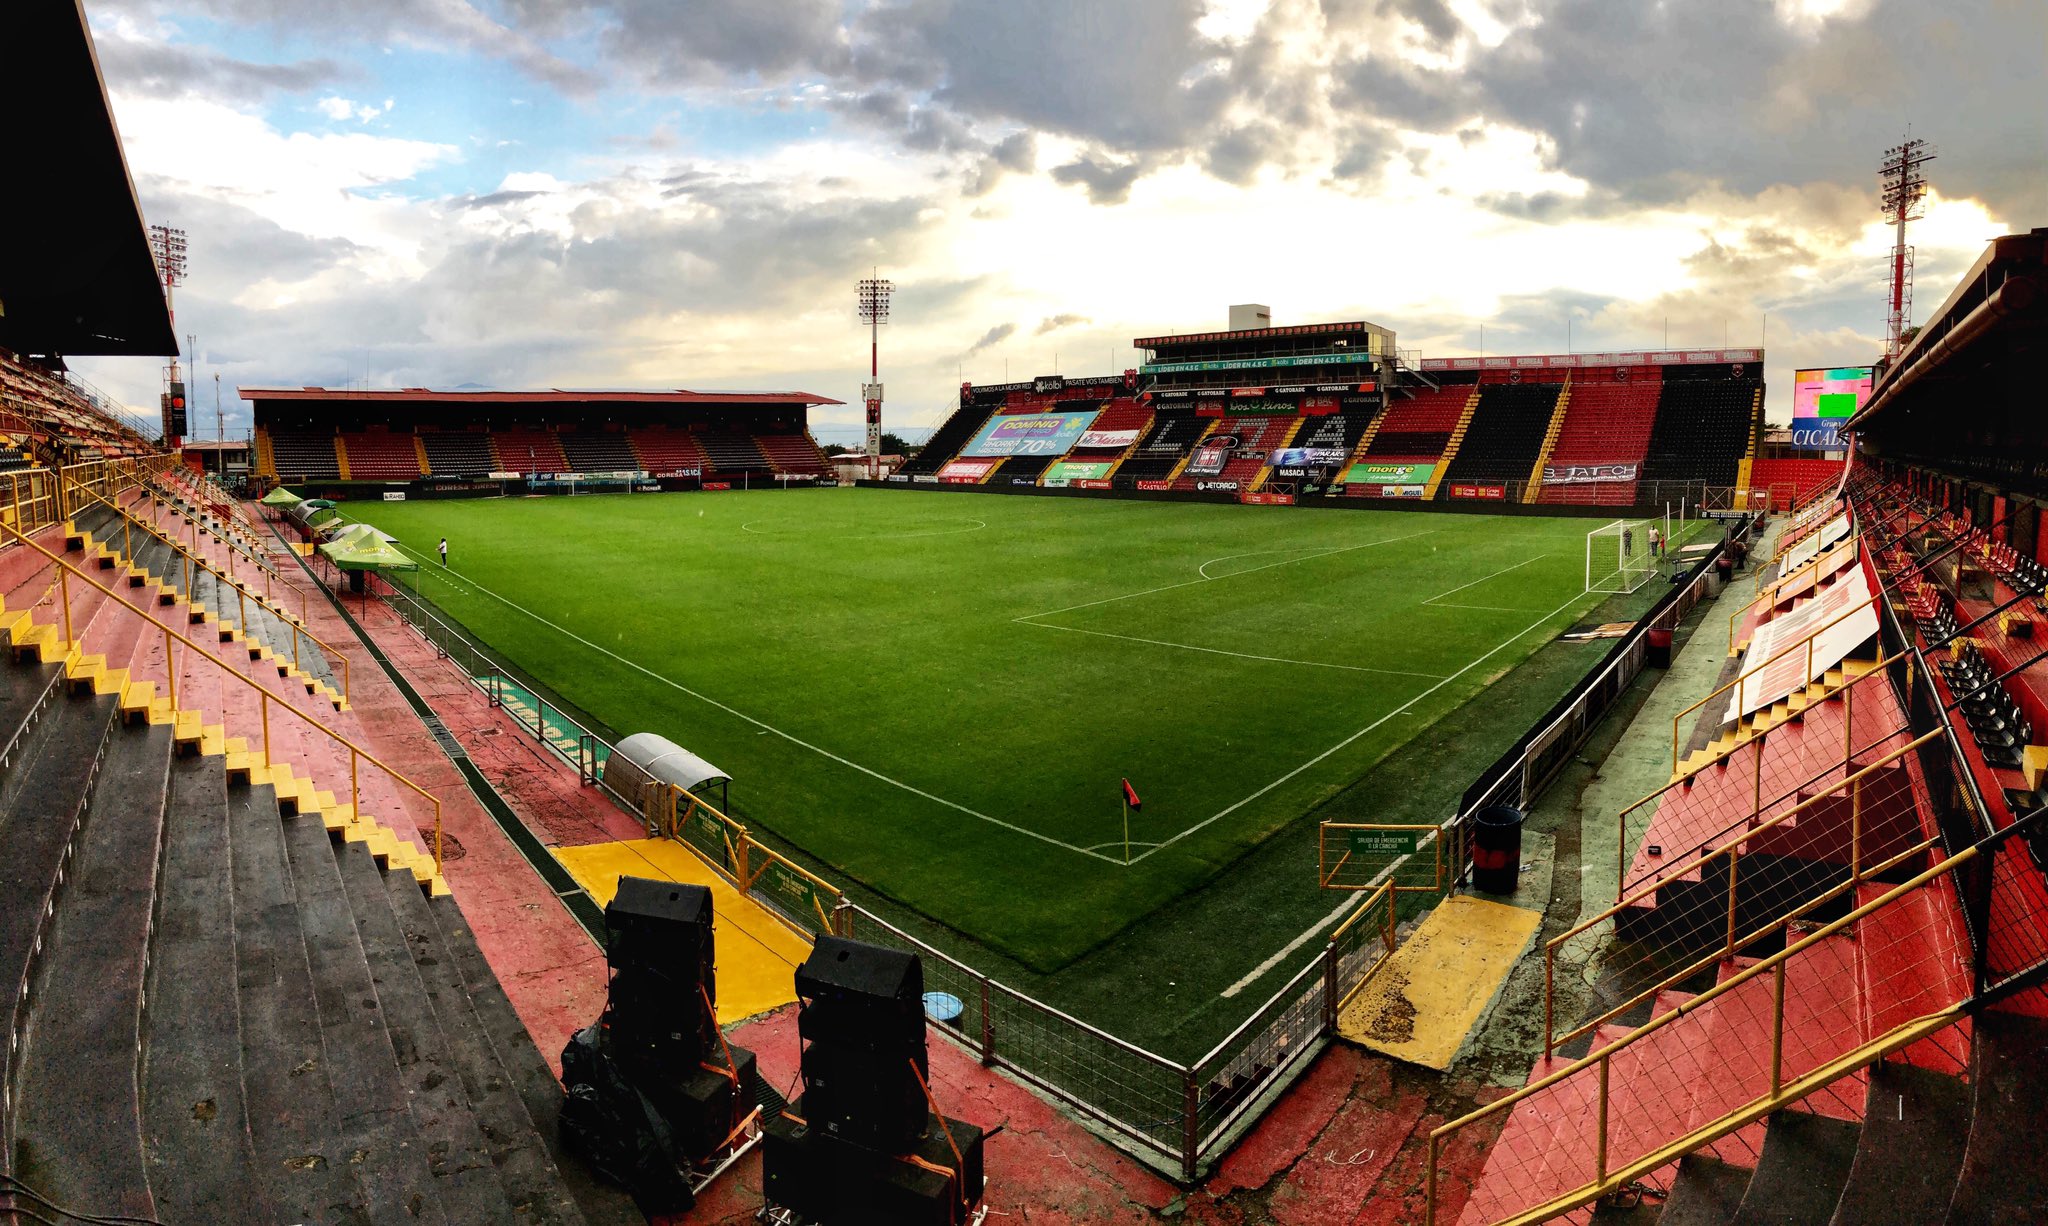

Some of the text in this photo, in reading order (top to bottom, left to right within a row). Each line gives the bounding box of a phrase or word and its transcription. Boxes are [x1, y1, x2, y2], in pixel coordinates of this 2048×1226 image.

[1003, 420, 1060, 430] DOMINIO
[1279, 469, 1305, 477] MASACA
[1367, 466, 1414, 475] monge
